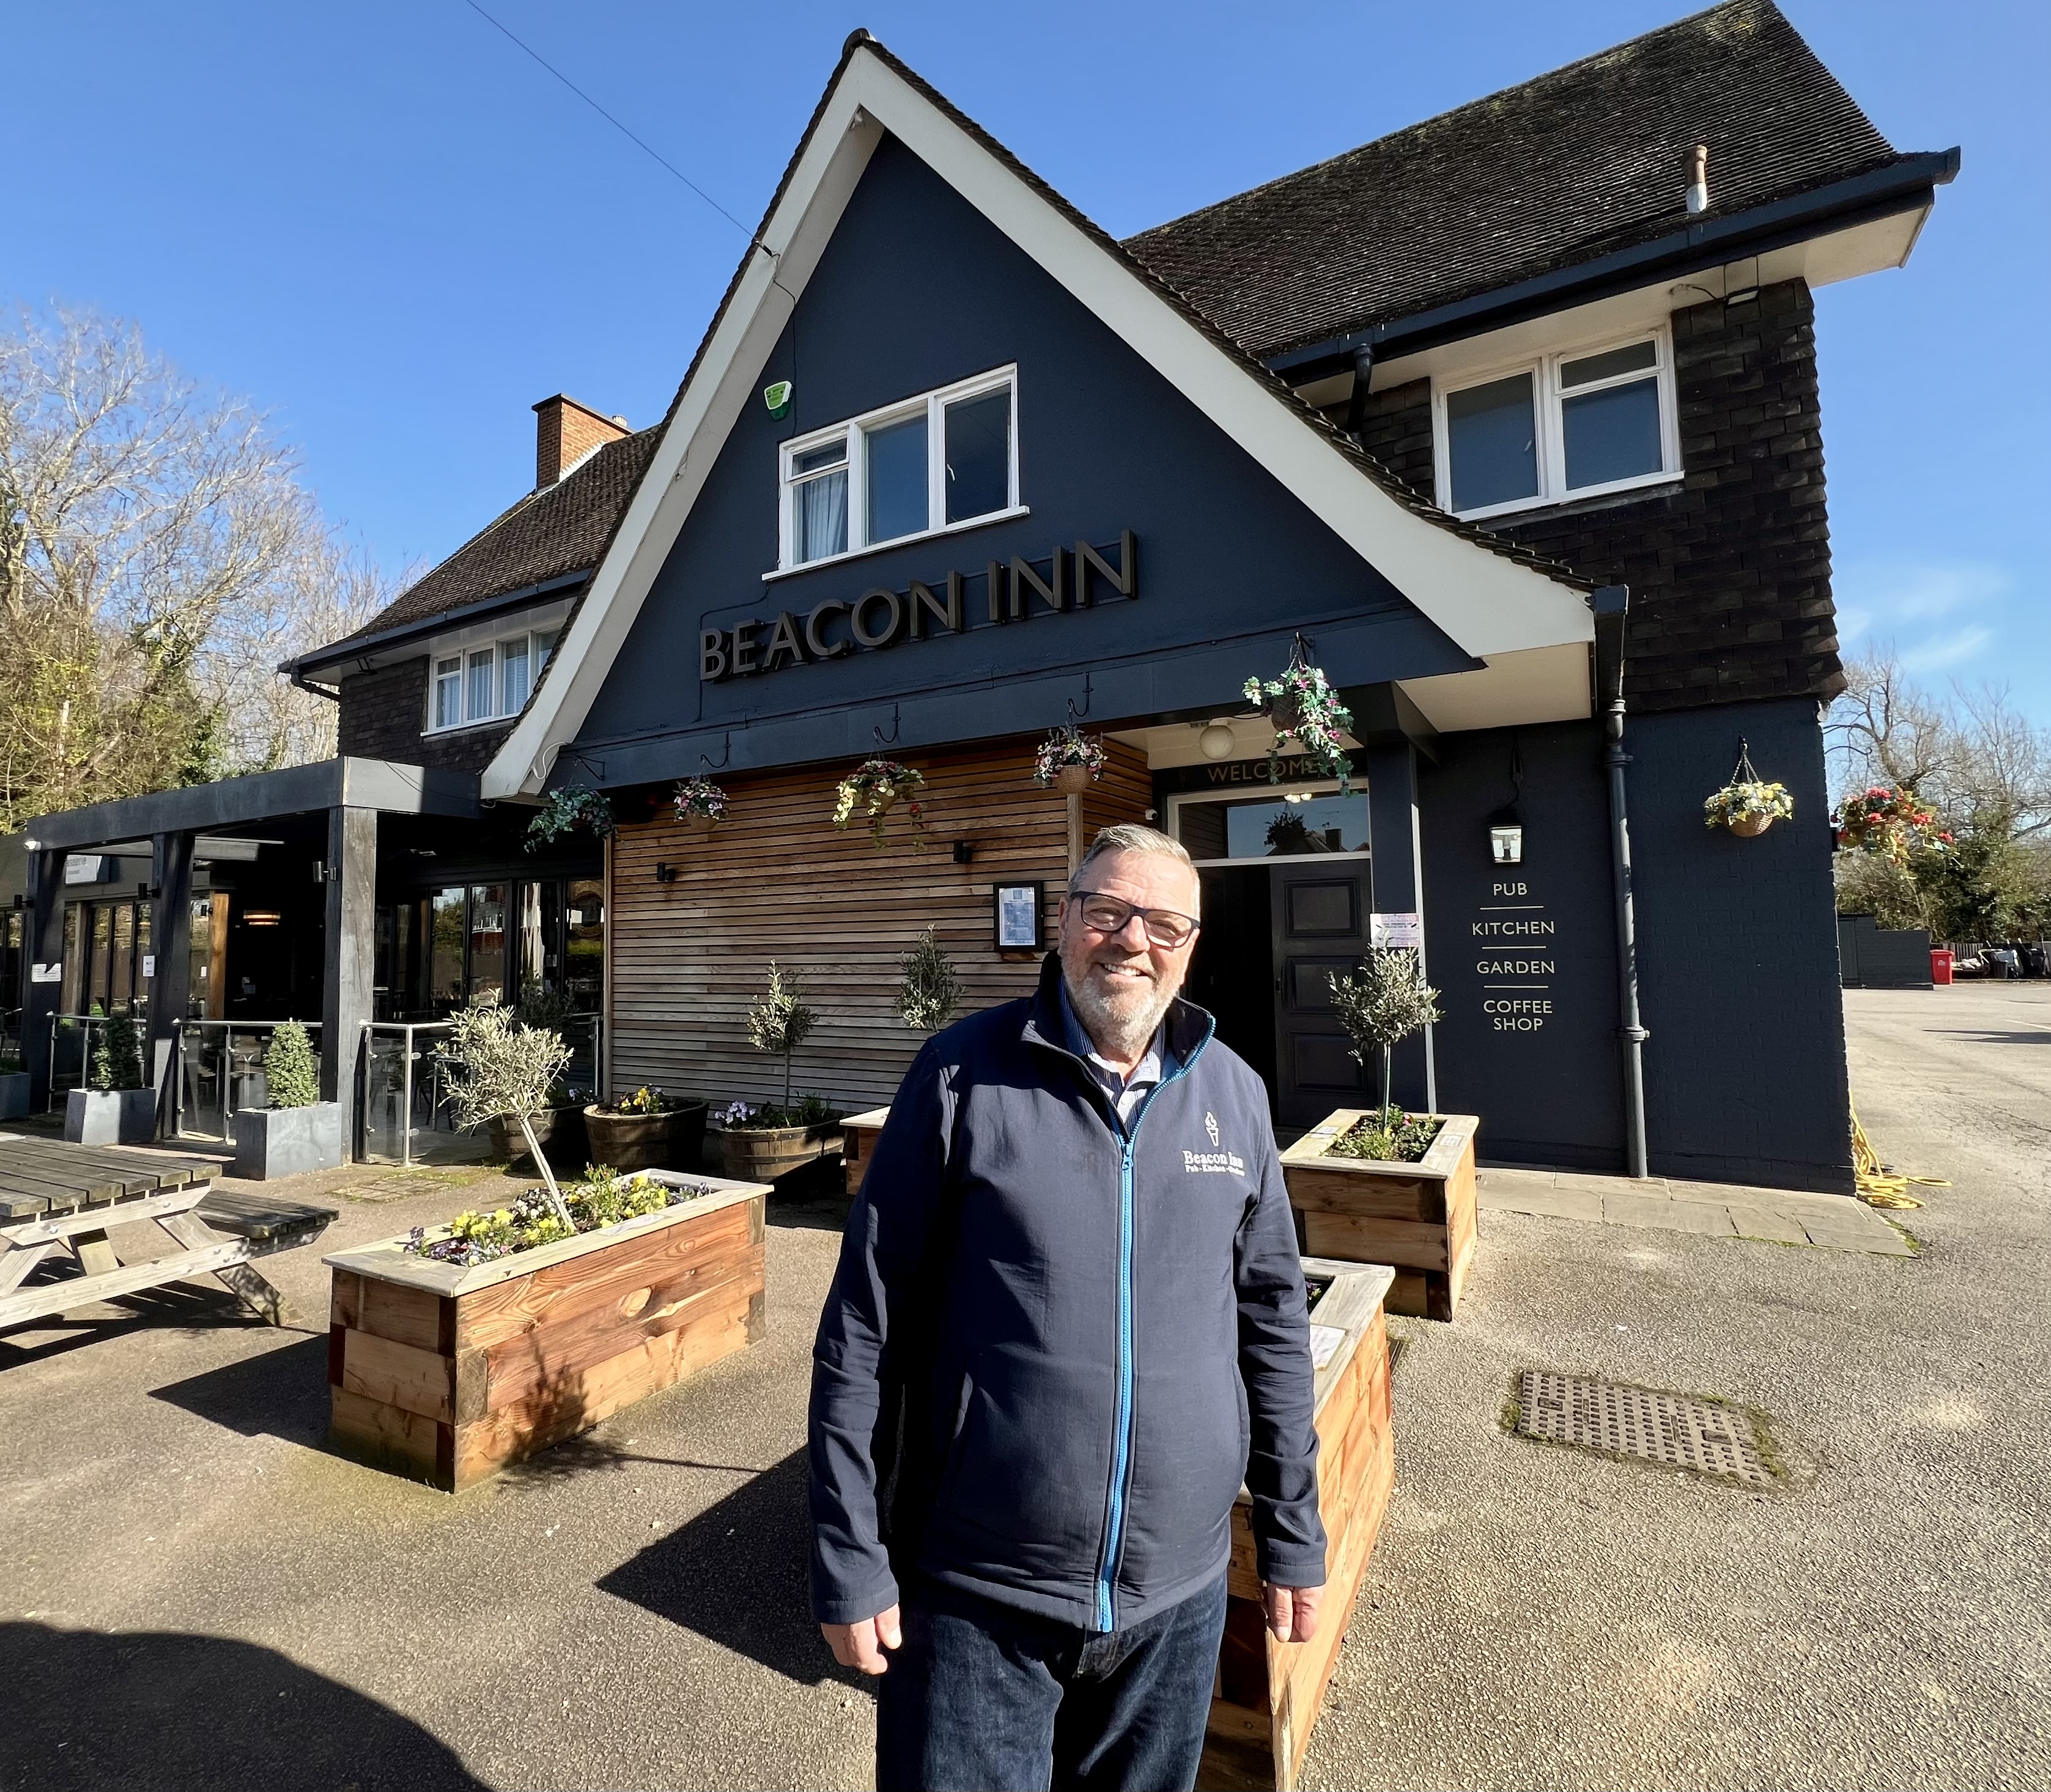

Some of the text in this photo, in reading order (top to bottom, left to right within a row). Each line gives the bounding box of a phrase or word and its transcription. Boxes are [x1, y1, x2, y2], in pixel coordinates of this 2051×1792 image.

[700, 529, 1138, 682] BEACON INN
[1207, 759, 1318, 782] WELCOME
[1493, 882, 1528, 896] PUB
[1472, 921, 1555, 935] KITCHEN
[1476, 961, 1555, 974] GARDEN
[1483, 1000, 1553, 1014] COFFEE
[1493, 1017, 1543, 1031] SHOP
[1182, 1150, 1243, 1168] Beacon Inn
